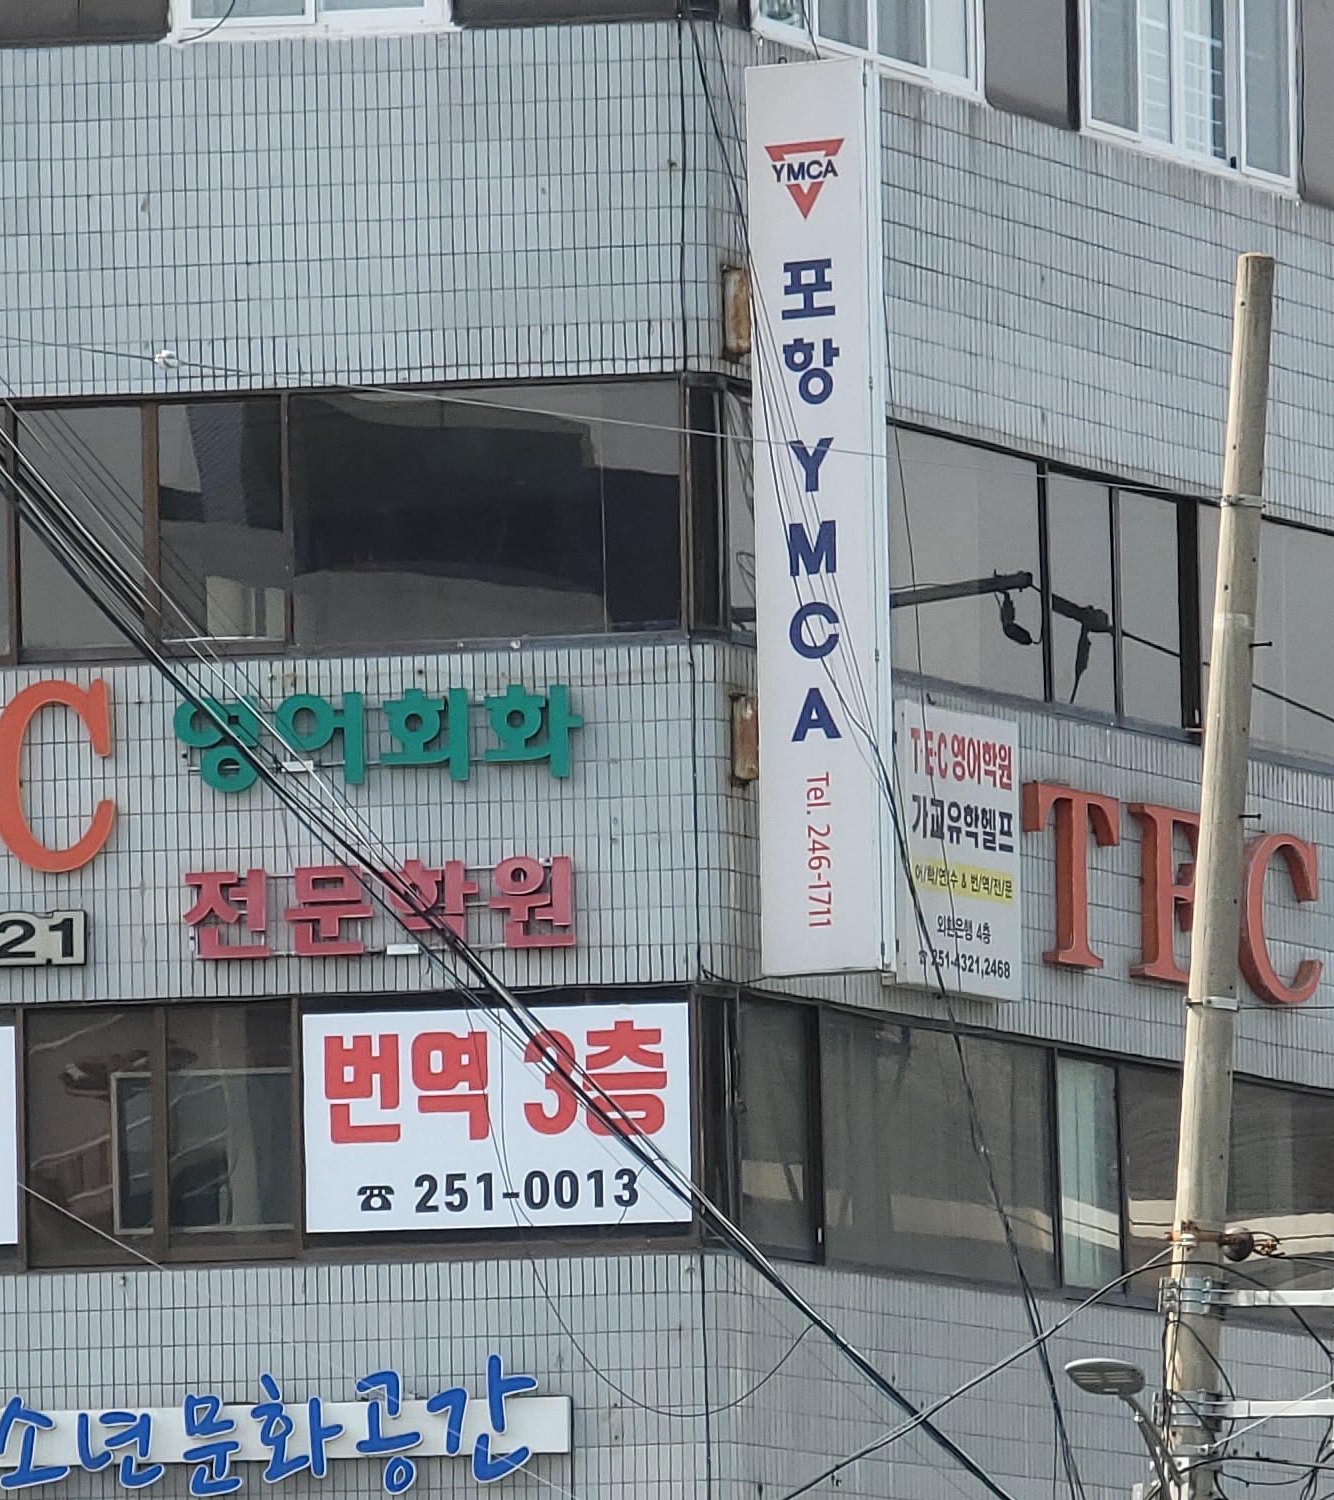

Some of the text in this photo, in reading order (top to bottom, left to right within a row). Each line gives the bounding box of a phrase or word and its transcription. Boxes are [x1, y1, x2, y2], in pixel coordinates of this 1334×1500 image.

[771, 159, 839, 183] YMCA
[173, 684, 584, 793] 영어회화
[950, 732, 1013, 791] 영어학원
[805, 771, 833, 930] Tel. 246-1711
[1022, 782, 1324, 1004] TEC
[182, 855, 576, 960] 전문학원
[323, 1020, 668, 1144] 번역 3층
[414, 1167, 640, 1214] 251-0013
